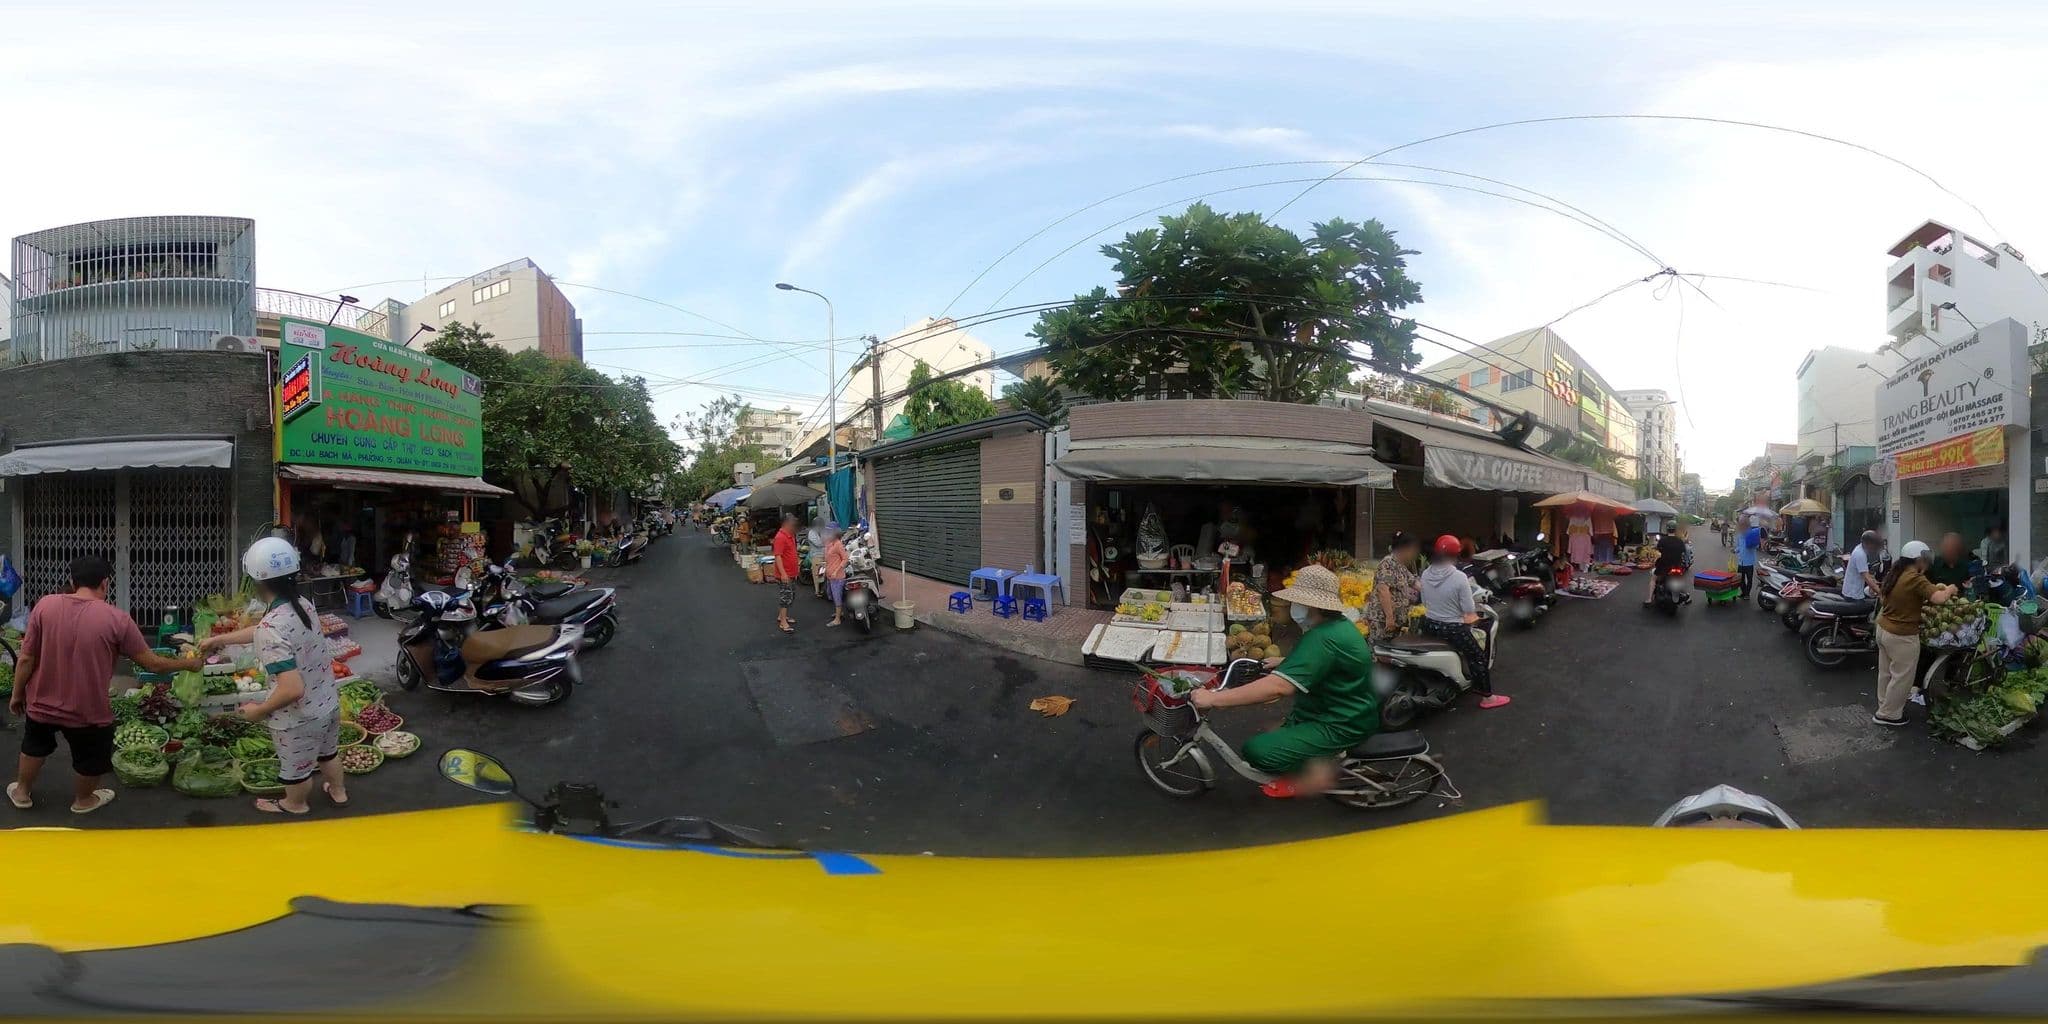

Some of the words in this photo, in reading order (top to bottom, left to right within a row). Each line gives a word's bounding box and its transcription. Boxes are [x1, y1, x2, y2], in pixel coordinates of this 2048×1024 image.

[330, 342, 411, 383] Hoàng
[415, 367, 460, 399] Long
[1886, 372, 1909, 390] TRUNG
[1928, 349, 1949, 367] DẠY
[1883, 404, 1918, 431] TRANG
[1920, 378, 1980, 415] BEAUTY
[1965, 392, 2004, 412] MASSAGE
[311, 432, 348, 446] CHUYÊN
[353, 436, 377, 449] CUNG
[326, 406, 412, 438] HOÀNG
[420, 422, 465, 448] LONG
[1491, 459, 1543, 485] COFFEE
